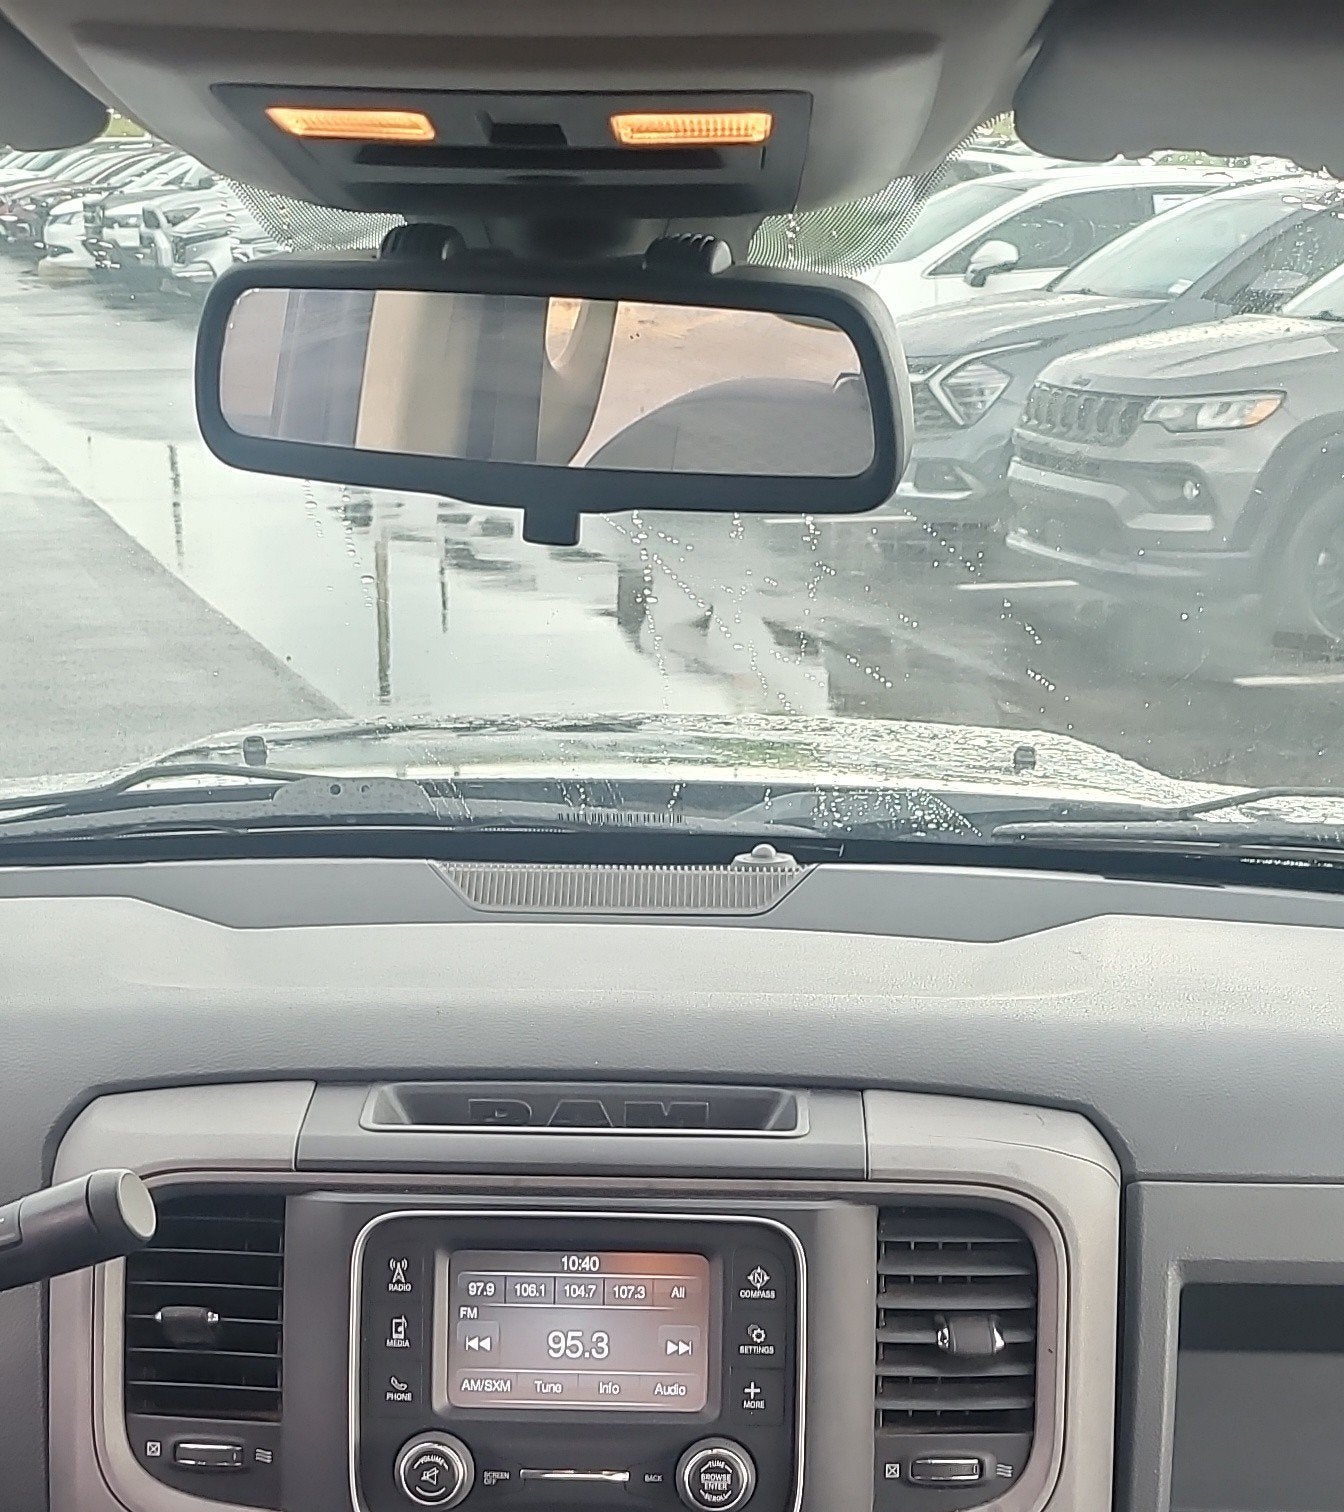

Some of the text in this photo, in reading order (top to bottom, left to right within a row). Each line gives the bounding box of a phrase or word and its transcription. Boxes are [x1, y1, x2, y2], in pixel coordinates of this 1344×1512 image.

[562, 1256, 600, 1271] 10:40
[388, 1282, 412, 1292] RADIO
[468, 1282, 686, 1300] 97.9 106.1 104.7 107.3 All
[740, 1289, 776, 1300] COMPASS
[459, 1306, 478, 1319] FM
[386, 1339, 410, 1348] MEDIA
[546, 1330, 610, 1360] 95.3
[740, 1345, 774, 1355] SETTINGS
[461, 1380, 686, 1396] AM/SXM Tune Info Audio
[386, 1393, 412, 1401] PHONE
[744, 1400, 765, 1410] MORE
[645, 1474, 662, 1482] BACK
[701, 1474, 732, 1484] BROWSE
[704, 1482, 728, 1490] ENTER
